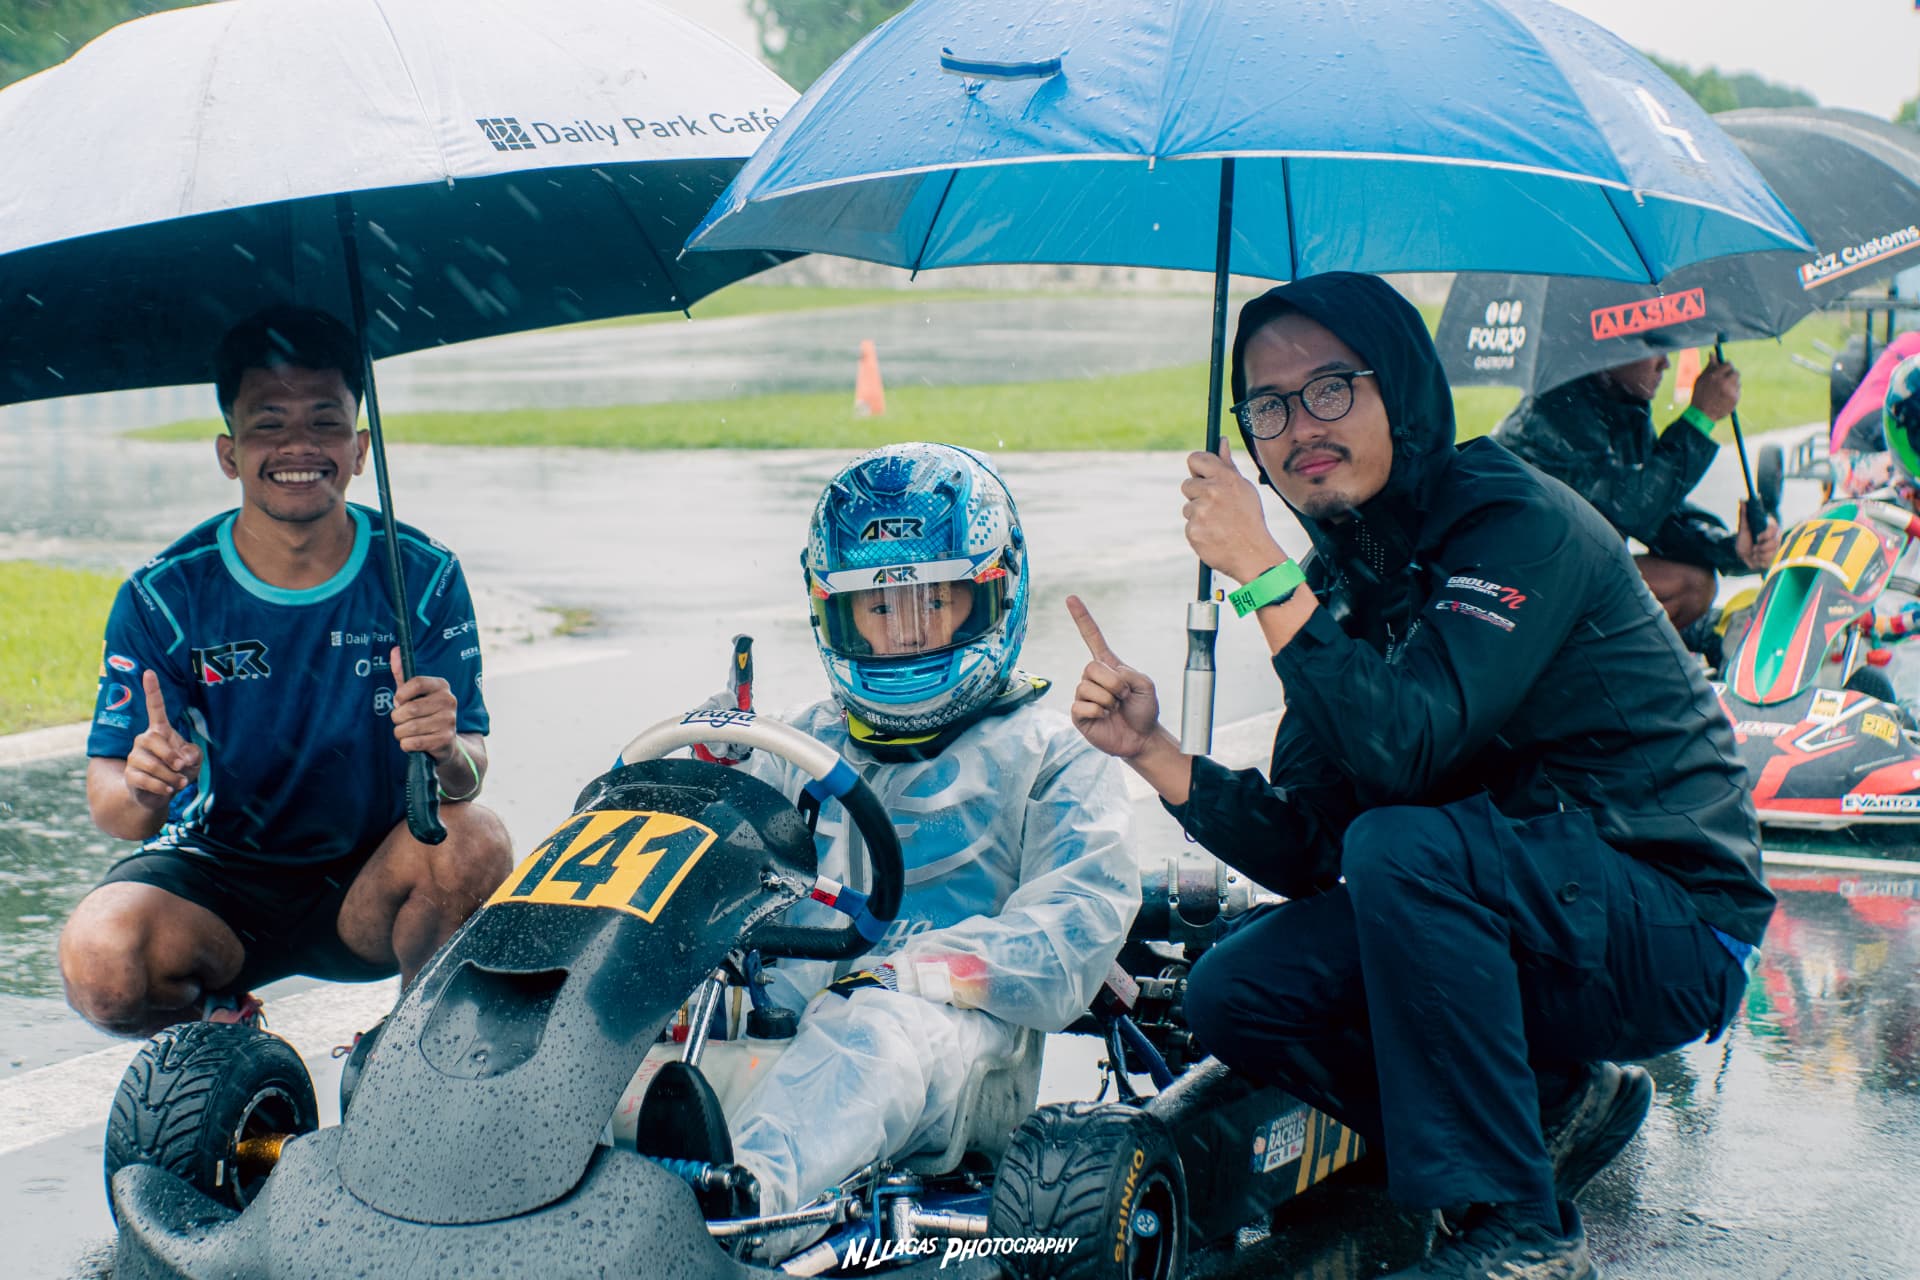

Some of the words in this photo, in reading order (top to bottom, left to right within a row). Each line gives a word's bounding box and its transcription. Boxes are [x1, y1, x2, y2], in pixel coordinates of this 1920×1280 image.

[531, 119, 620, 147] Daily
[622, 114, 707, 140] Park
[708, 107, 780, 134] Café
[1841, 225, 1920, 265] Customs
[1593, 290, 1703, 338] ALASKA
[1447, 576, 1502, 590] GROUP
[345, 632, 370, 646] Daily
[510, 814, 710, 914] 141
[1114, 1149, 1145, 1263] SHINKO
